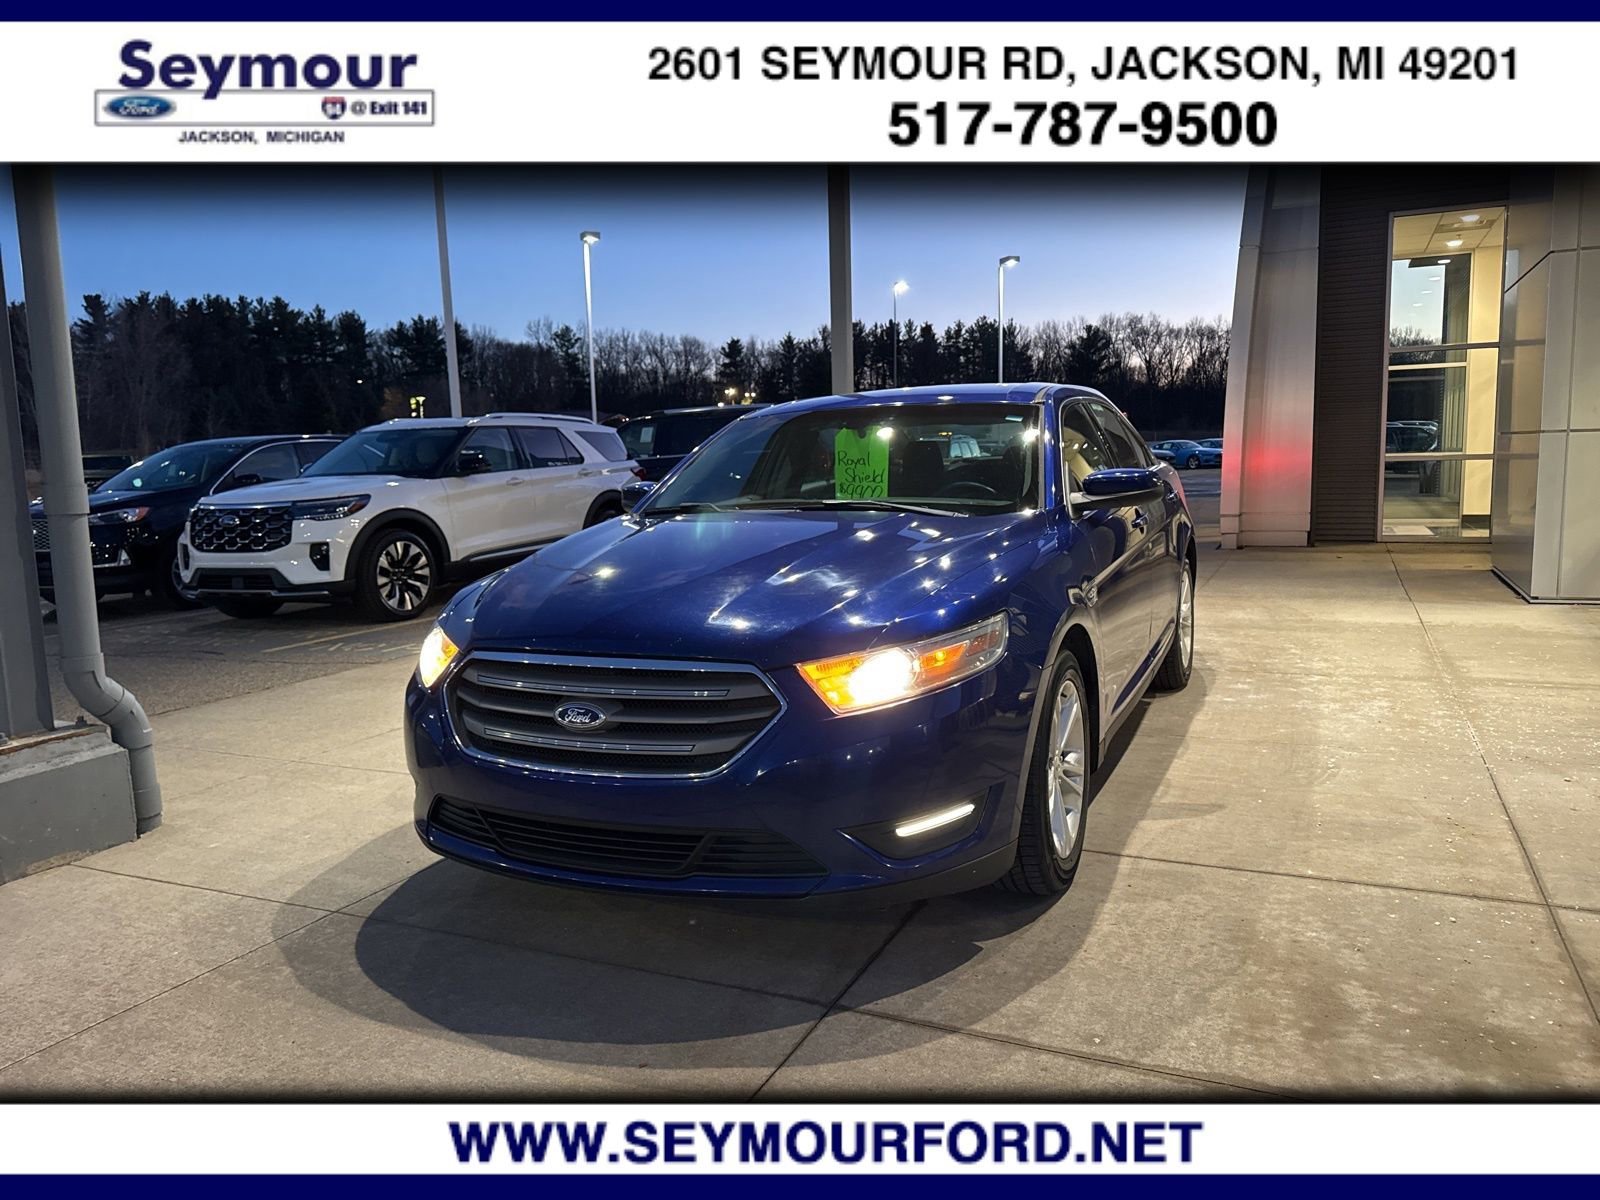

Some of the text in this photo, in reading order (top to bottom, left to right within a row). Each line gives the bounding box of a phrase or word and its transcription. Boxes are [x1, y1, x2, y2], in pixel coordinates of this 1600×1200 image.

[837, 450, 871, 469] Royal
[845, 467, 886, 483] Shield
[564, 707, 592, 723] Ford
